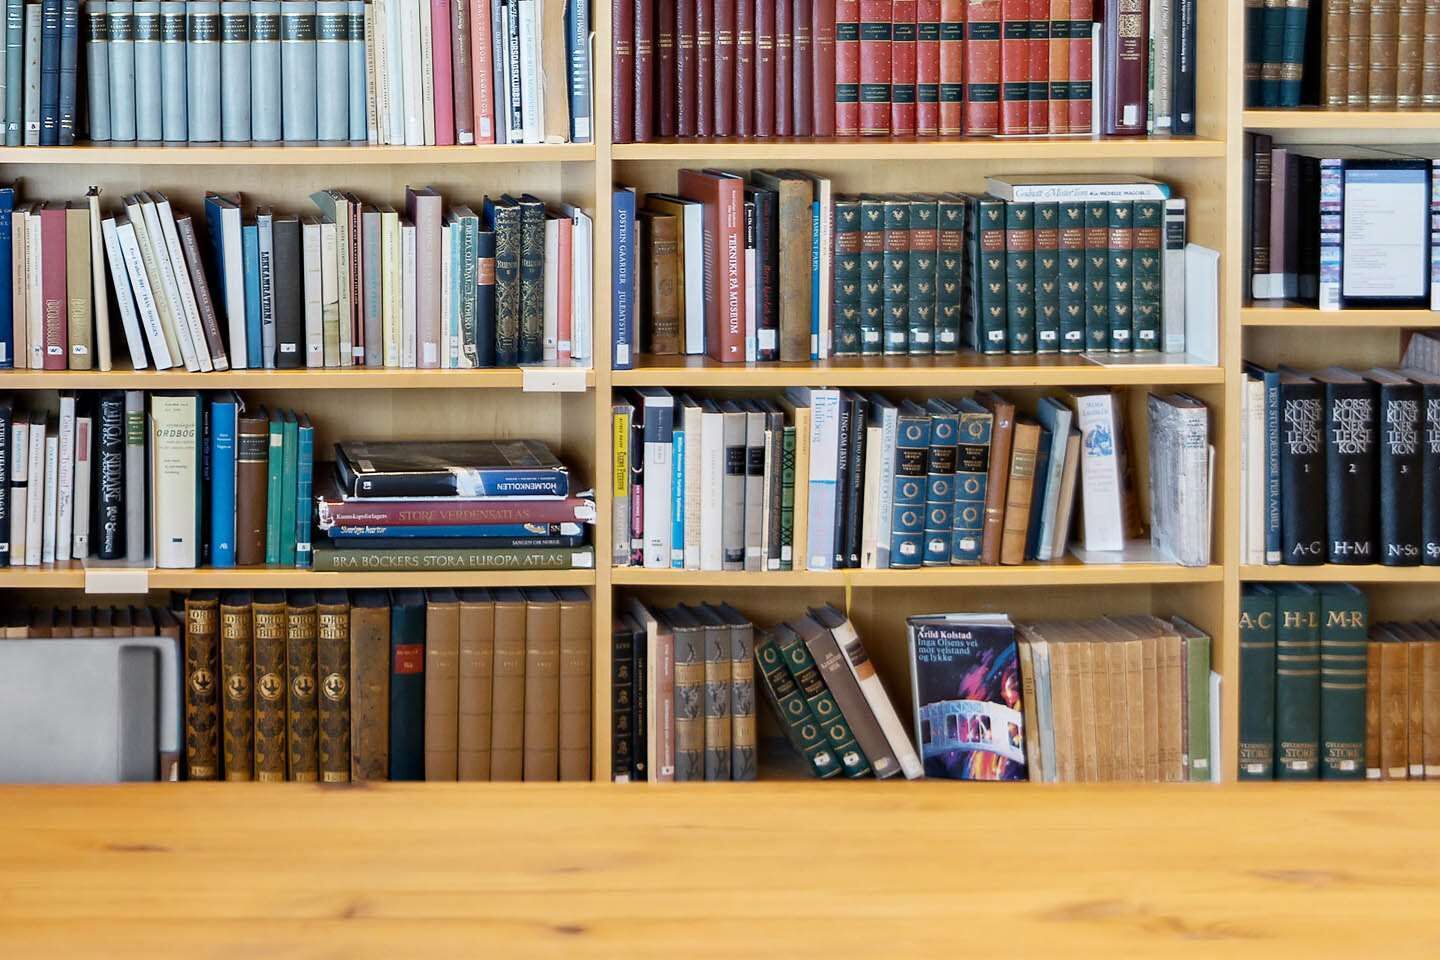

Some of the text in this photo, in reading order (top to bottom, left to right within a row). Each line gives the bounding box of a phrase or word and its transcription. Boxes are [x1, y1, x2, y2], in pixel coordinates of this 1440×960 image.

[510, 36, 520, 107] TORSDAGSKLUBBEN
[618, 208, 627, 284] JOSTEIN GAARDER
[261, 250, 272, 326] LEKKAMRATERNA
[728, 234, 738, 334] TEKNIKK PÅ MUSEUM
[1269, 386, 1278, 400] DEN
[1292, 421, 1316, 432] NER
[1340, 421, 1365, 432] NER
[1392, 422, 1412, 432] NER
[156, 429, 194, 437] ORDBOG
[840, 412, 848, 470] TING OM IBSEN
[1290, 442, 1319, 454] KON
[1338, 442, 1366, 454] KON
[1392, 443, 1416, 454] KON
[1304, 464, 1310, 472] 1
[1348, 464, 1356, 472] 2
[1400, 465, 1407, 474] 3
[496, 482, 557, 492] HOLMENKOLLEN
[398, 510, 530, 521] STORE VERDENSATLAS
[1334, 542, 1368, 554] H-M
[1388, 544, 1418, 556] N-So
[333, 554, 564, 567] BRA BÖCKERS STORA EUROPA ATLAS
[1284, 612, 1318, 628] H-L
[1327, 612, 1364, 628] M-R
[917, 630, 972, 640] Arild Kolstad
[918, 639, 936, 648] Inga
[938, 639, 964, 647] Olsens
[936, 646, 970, 654] velstand
[930, 654, 952, 662] lykke
